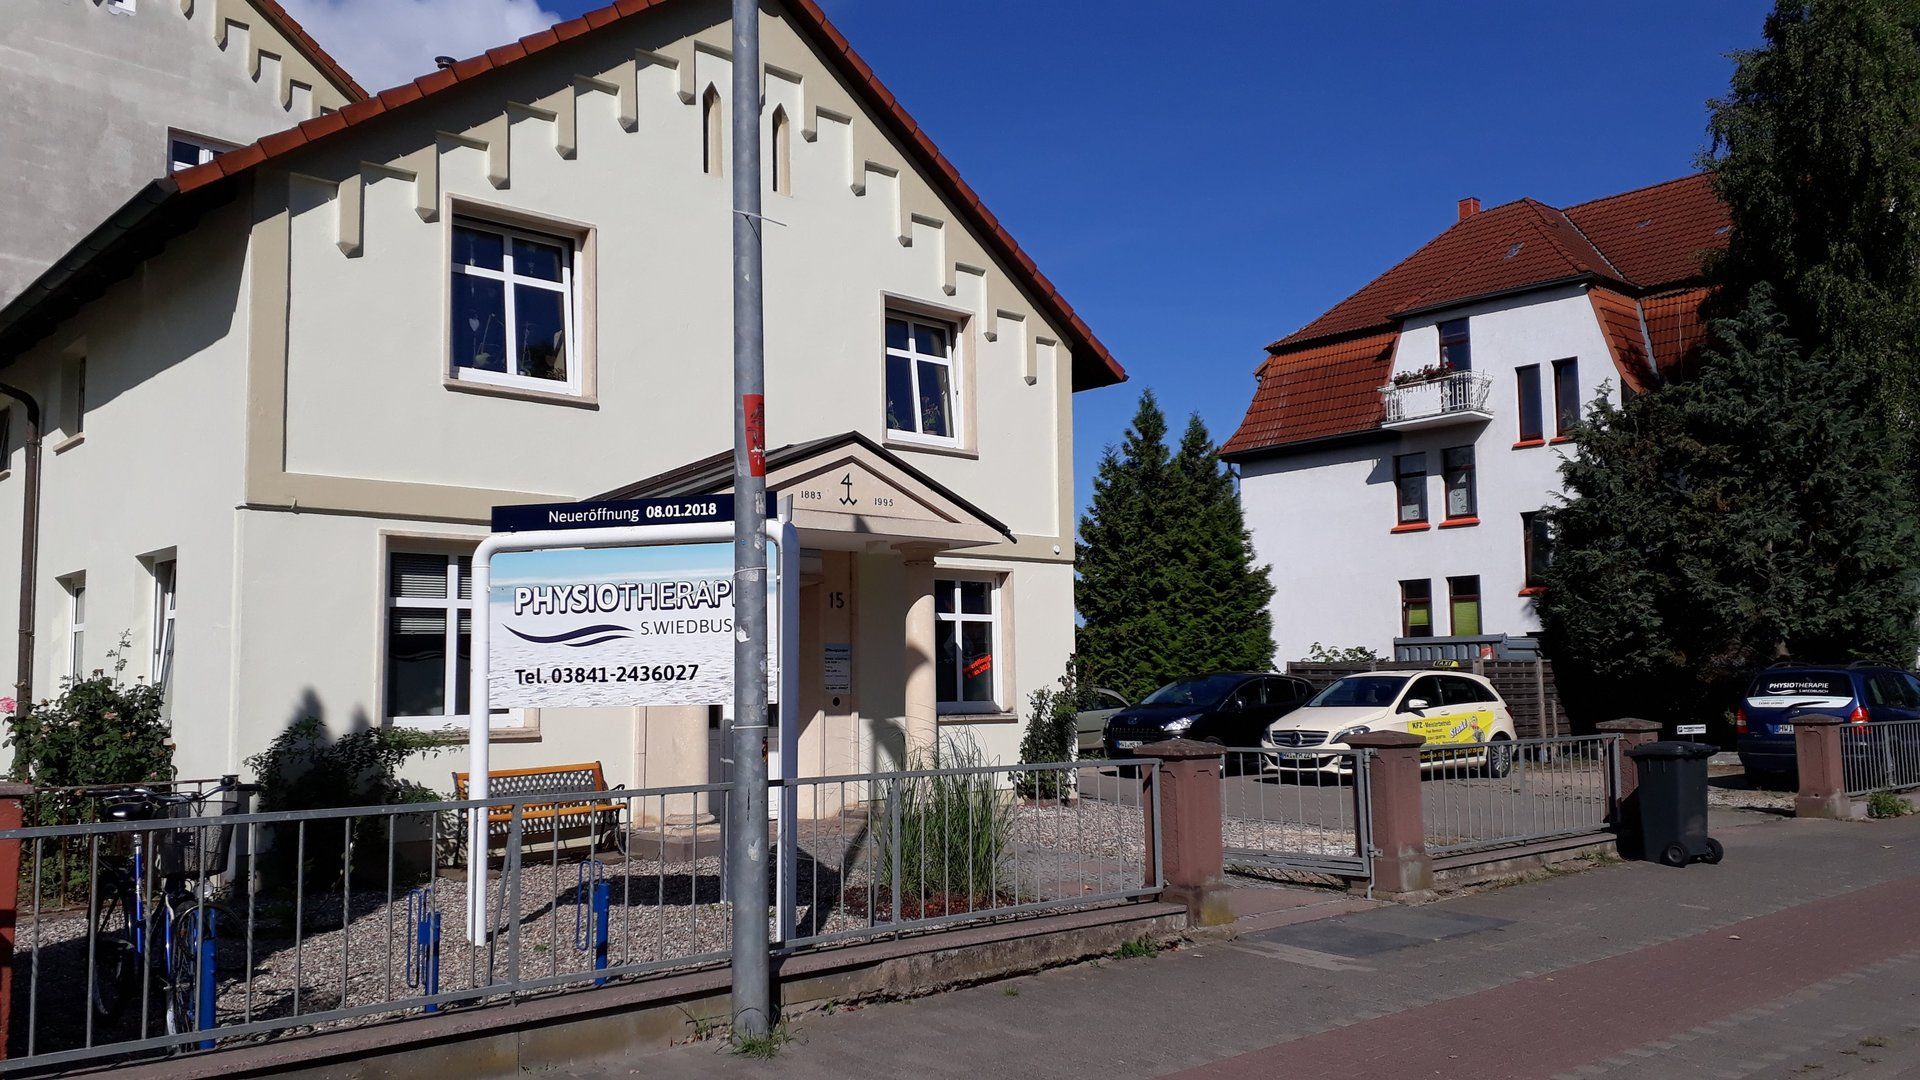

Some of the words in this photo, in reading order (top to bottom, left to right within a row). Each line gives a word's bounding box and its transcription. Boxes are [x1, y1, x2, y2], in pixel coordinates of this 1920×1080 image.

[801, 490, 821, 500] 1883
[874, 498, 894, 506] 1995
[548, 508, 640, 523] Neueröffnung
[646, 502, 717, 518] 08.01.2018
[829, 591, 845, 609] 15
[640, 618, 735, 636] S.WIEDBUS
[515, 668, 547, 685] Tel.
[551, 664, 699, 684] 03841-2436027
